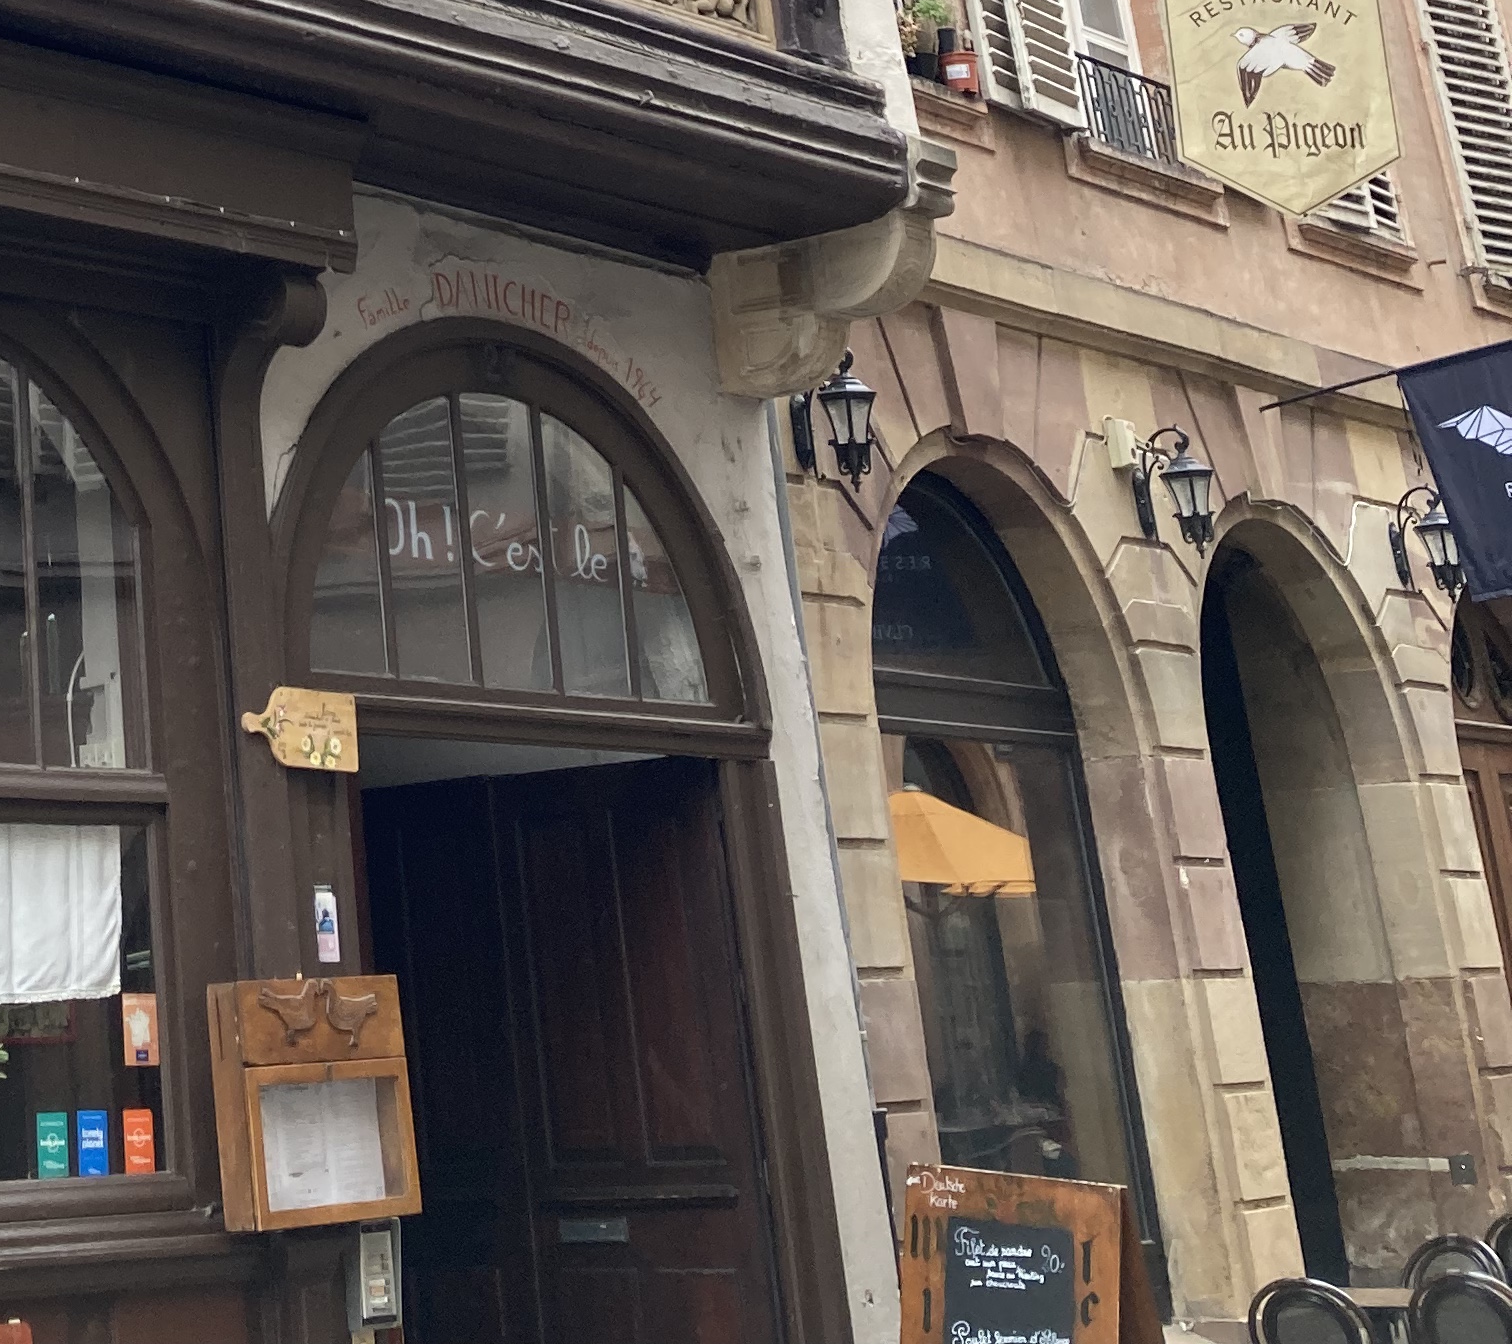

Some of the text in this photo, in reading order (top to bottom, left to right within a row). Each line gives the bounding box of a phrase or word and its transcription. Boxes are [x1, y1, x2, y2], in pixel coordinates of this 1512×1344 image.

[1211, 111, 1366, 159] Au Pigeon
[433, 269, 571, 334] DANICHER
[571, 524, 609, 583] le
